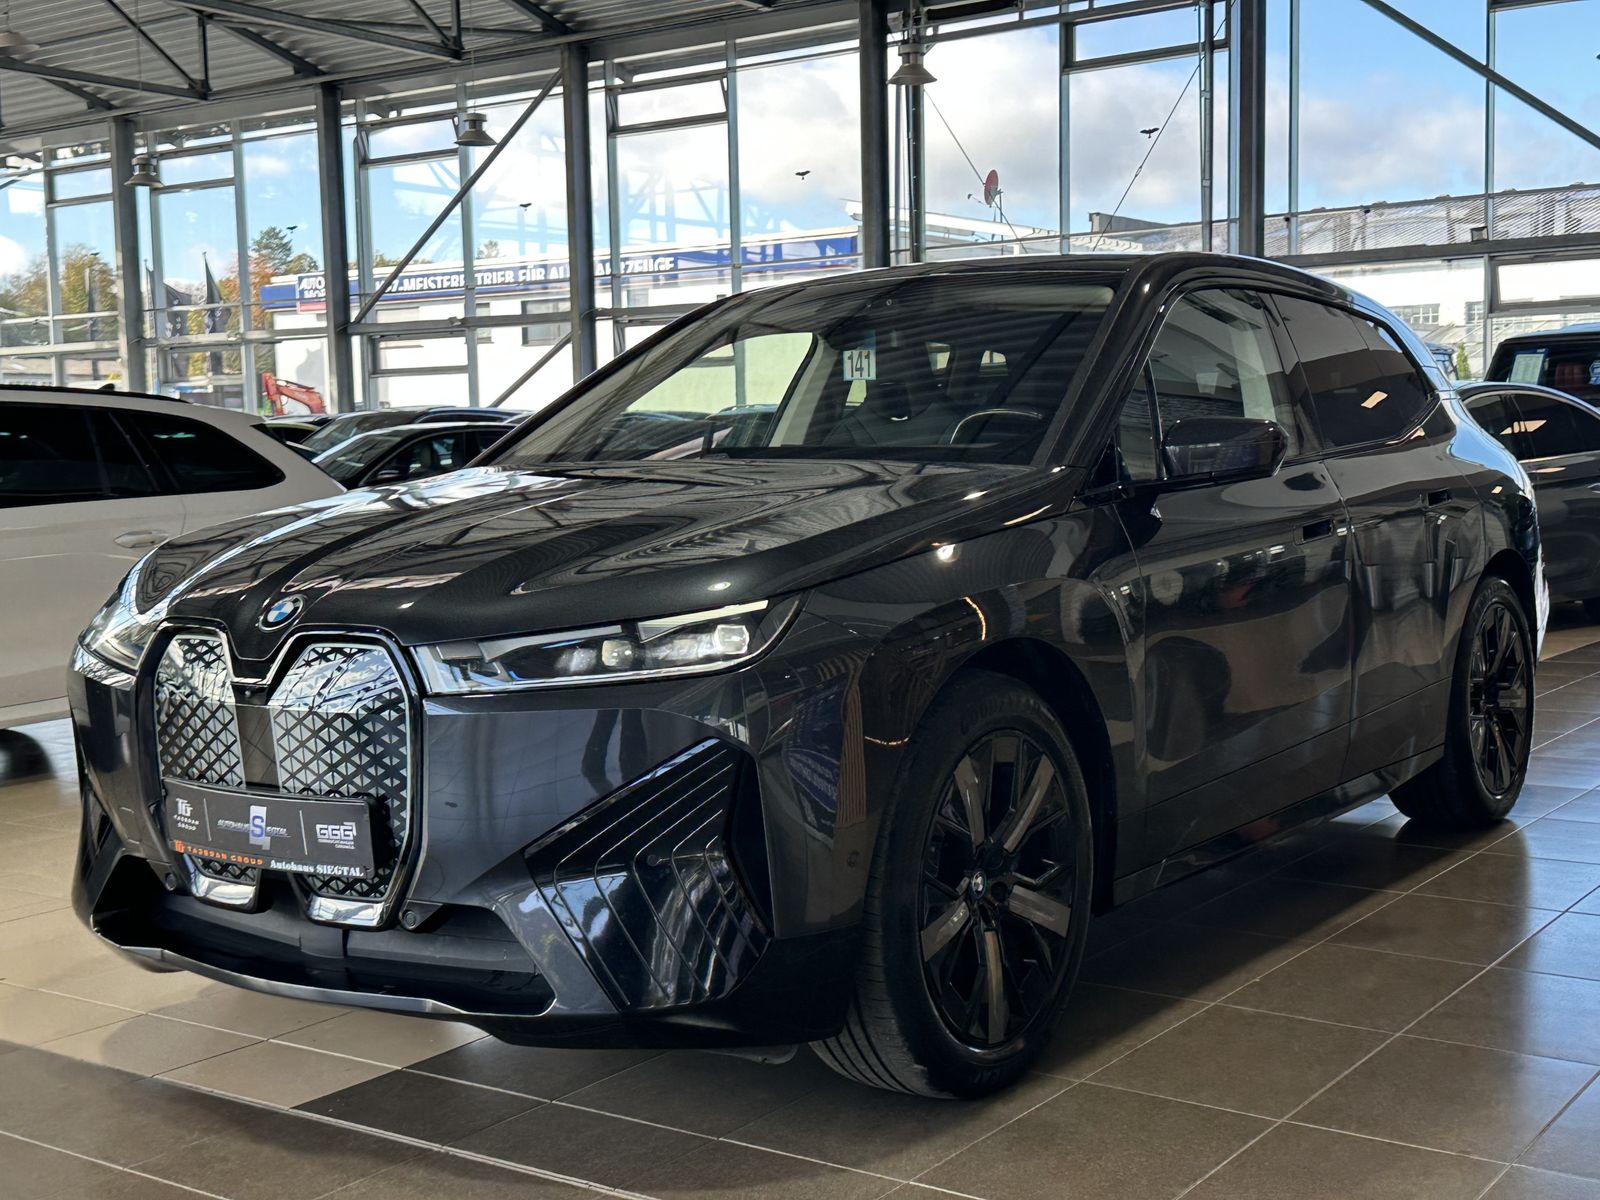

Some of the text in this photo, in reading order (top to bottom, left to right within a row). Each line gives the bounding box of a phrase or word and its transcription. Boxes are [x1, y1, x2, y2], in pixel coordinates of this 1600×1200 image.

[518, 264, 546, 283] FÜR
[847, 350, 871, 378] 141
[316, 822, 355, 840] GGG
[270, 859, 365, 877] Autohaus SIEGTAL
